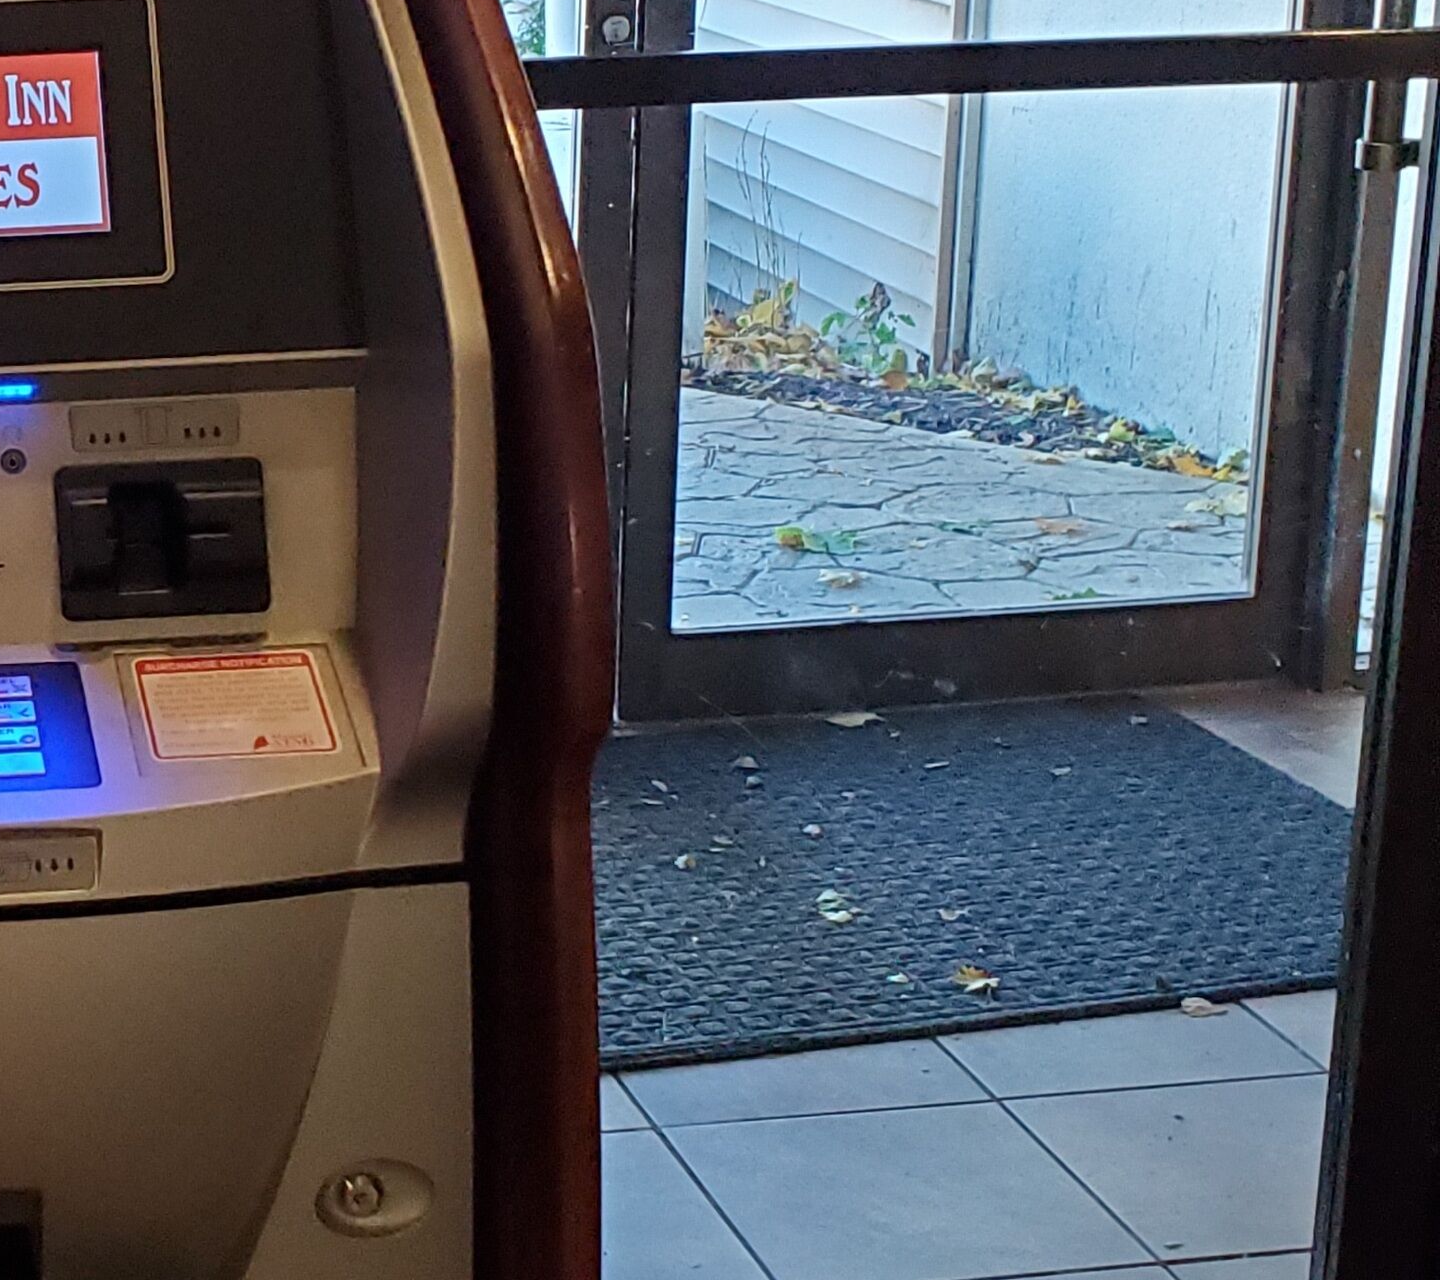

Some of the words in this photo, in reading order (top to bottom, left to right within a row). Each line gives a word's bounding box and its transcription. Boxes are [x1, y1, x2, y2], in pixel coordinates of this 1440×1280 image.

[4, 74, 71, 127] INN
[143, 659, 217, 672] SURCHARGE
[220, 655, 303, 668] NOTIFICATION
